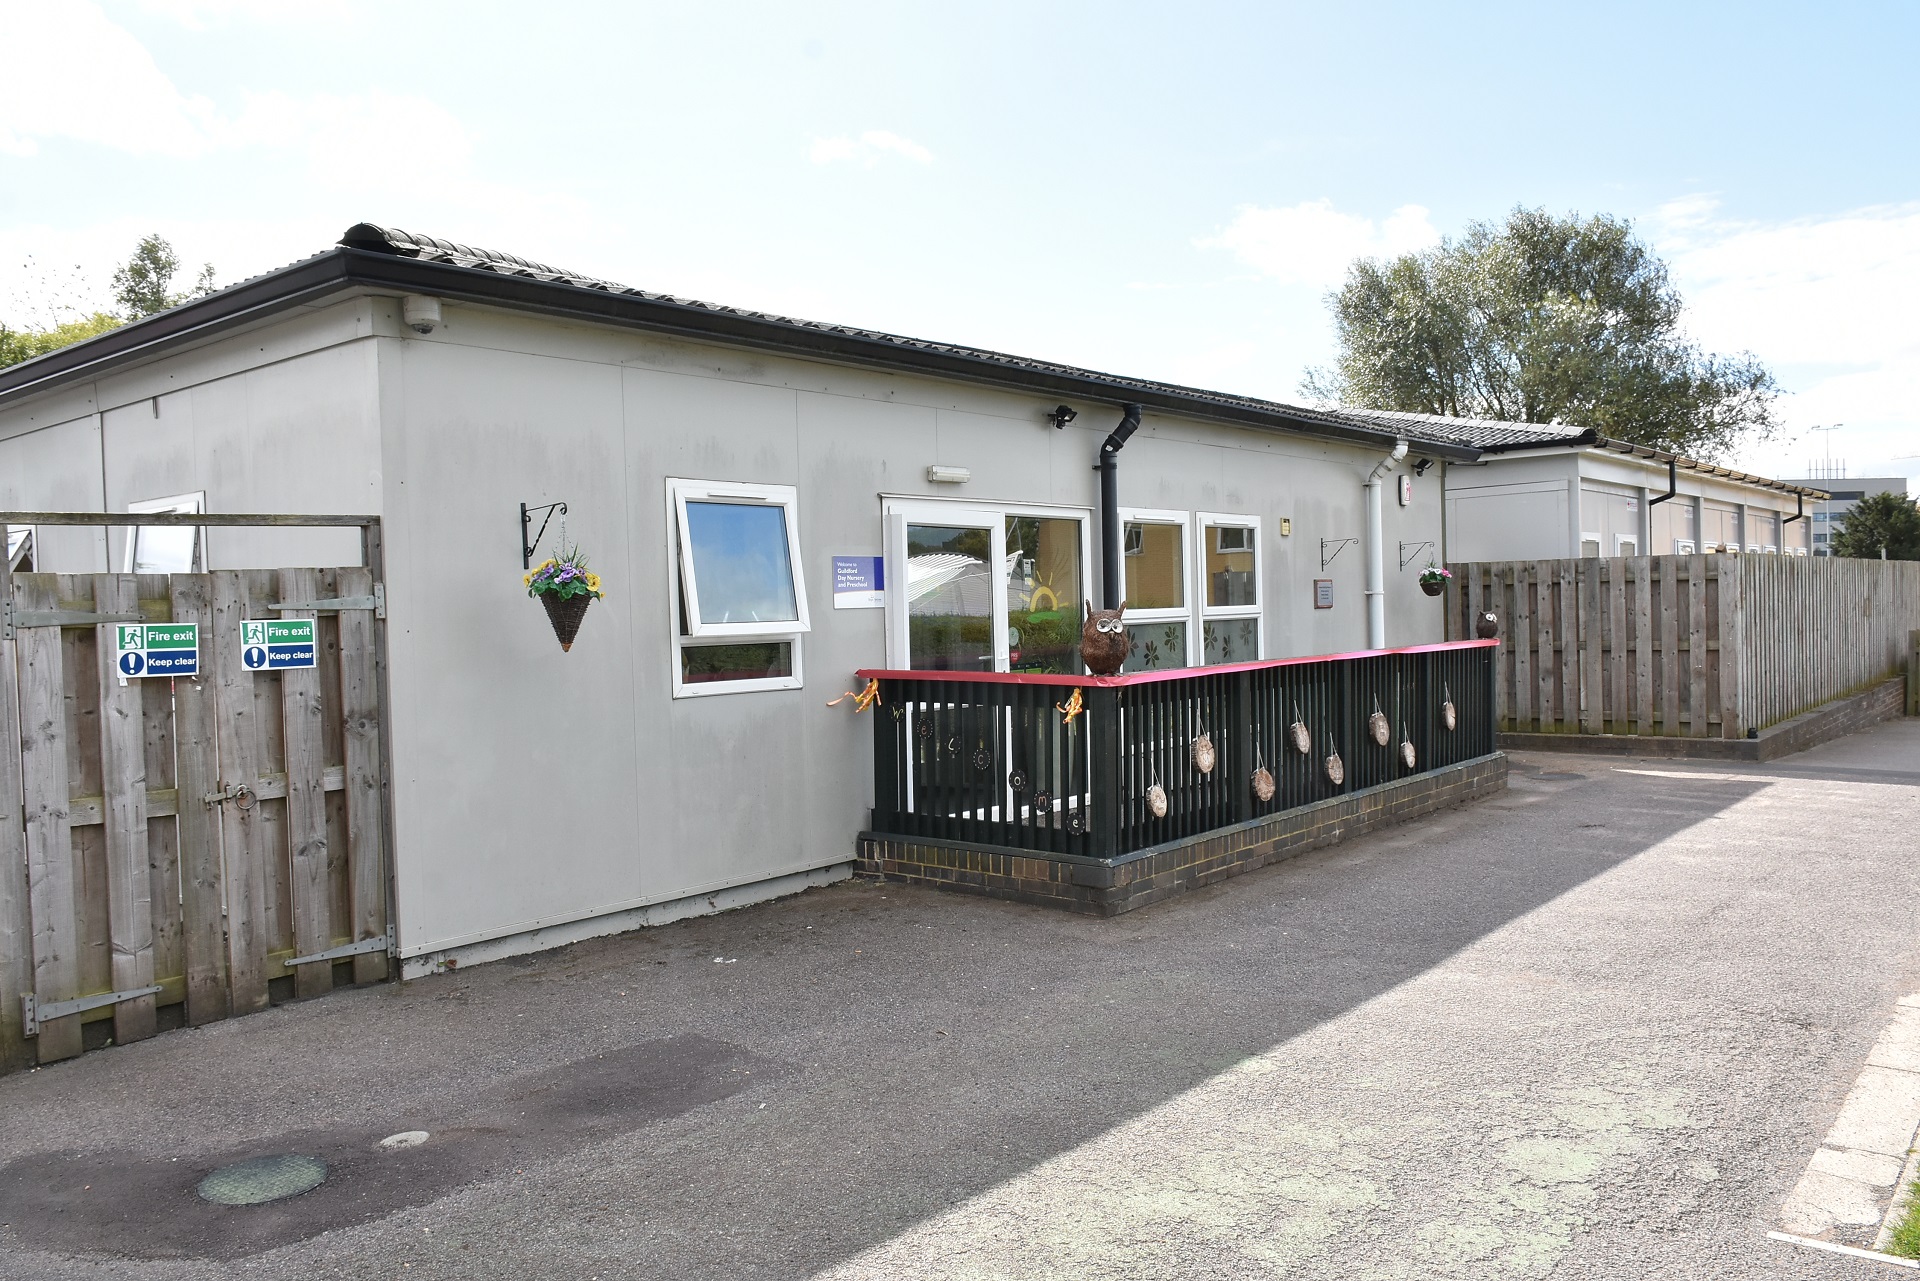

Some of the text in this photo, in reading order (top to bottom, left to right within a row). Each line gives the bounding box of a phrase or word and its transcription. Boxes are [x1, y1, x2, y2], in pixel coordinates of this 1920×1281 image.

[148, 630, 194, 641] Fire exit
[268, 626, 311, 636] Fire exit
[269, 651, 314, 662] Keep clear
[148, 657, 196, 668] Keep clear
